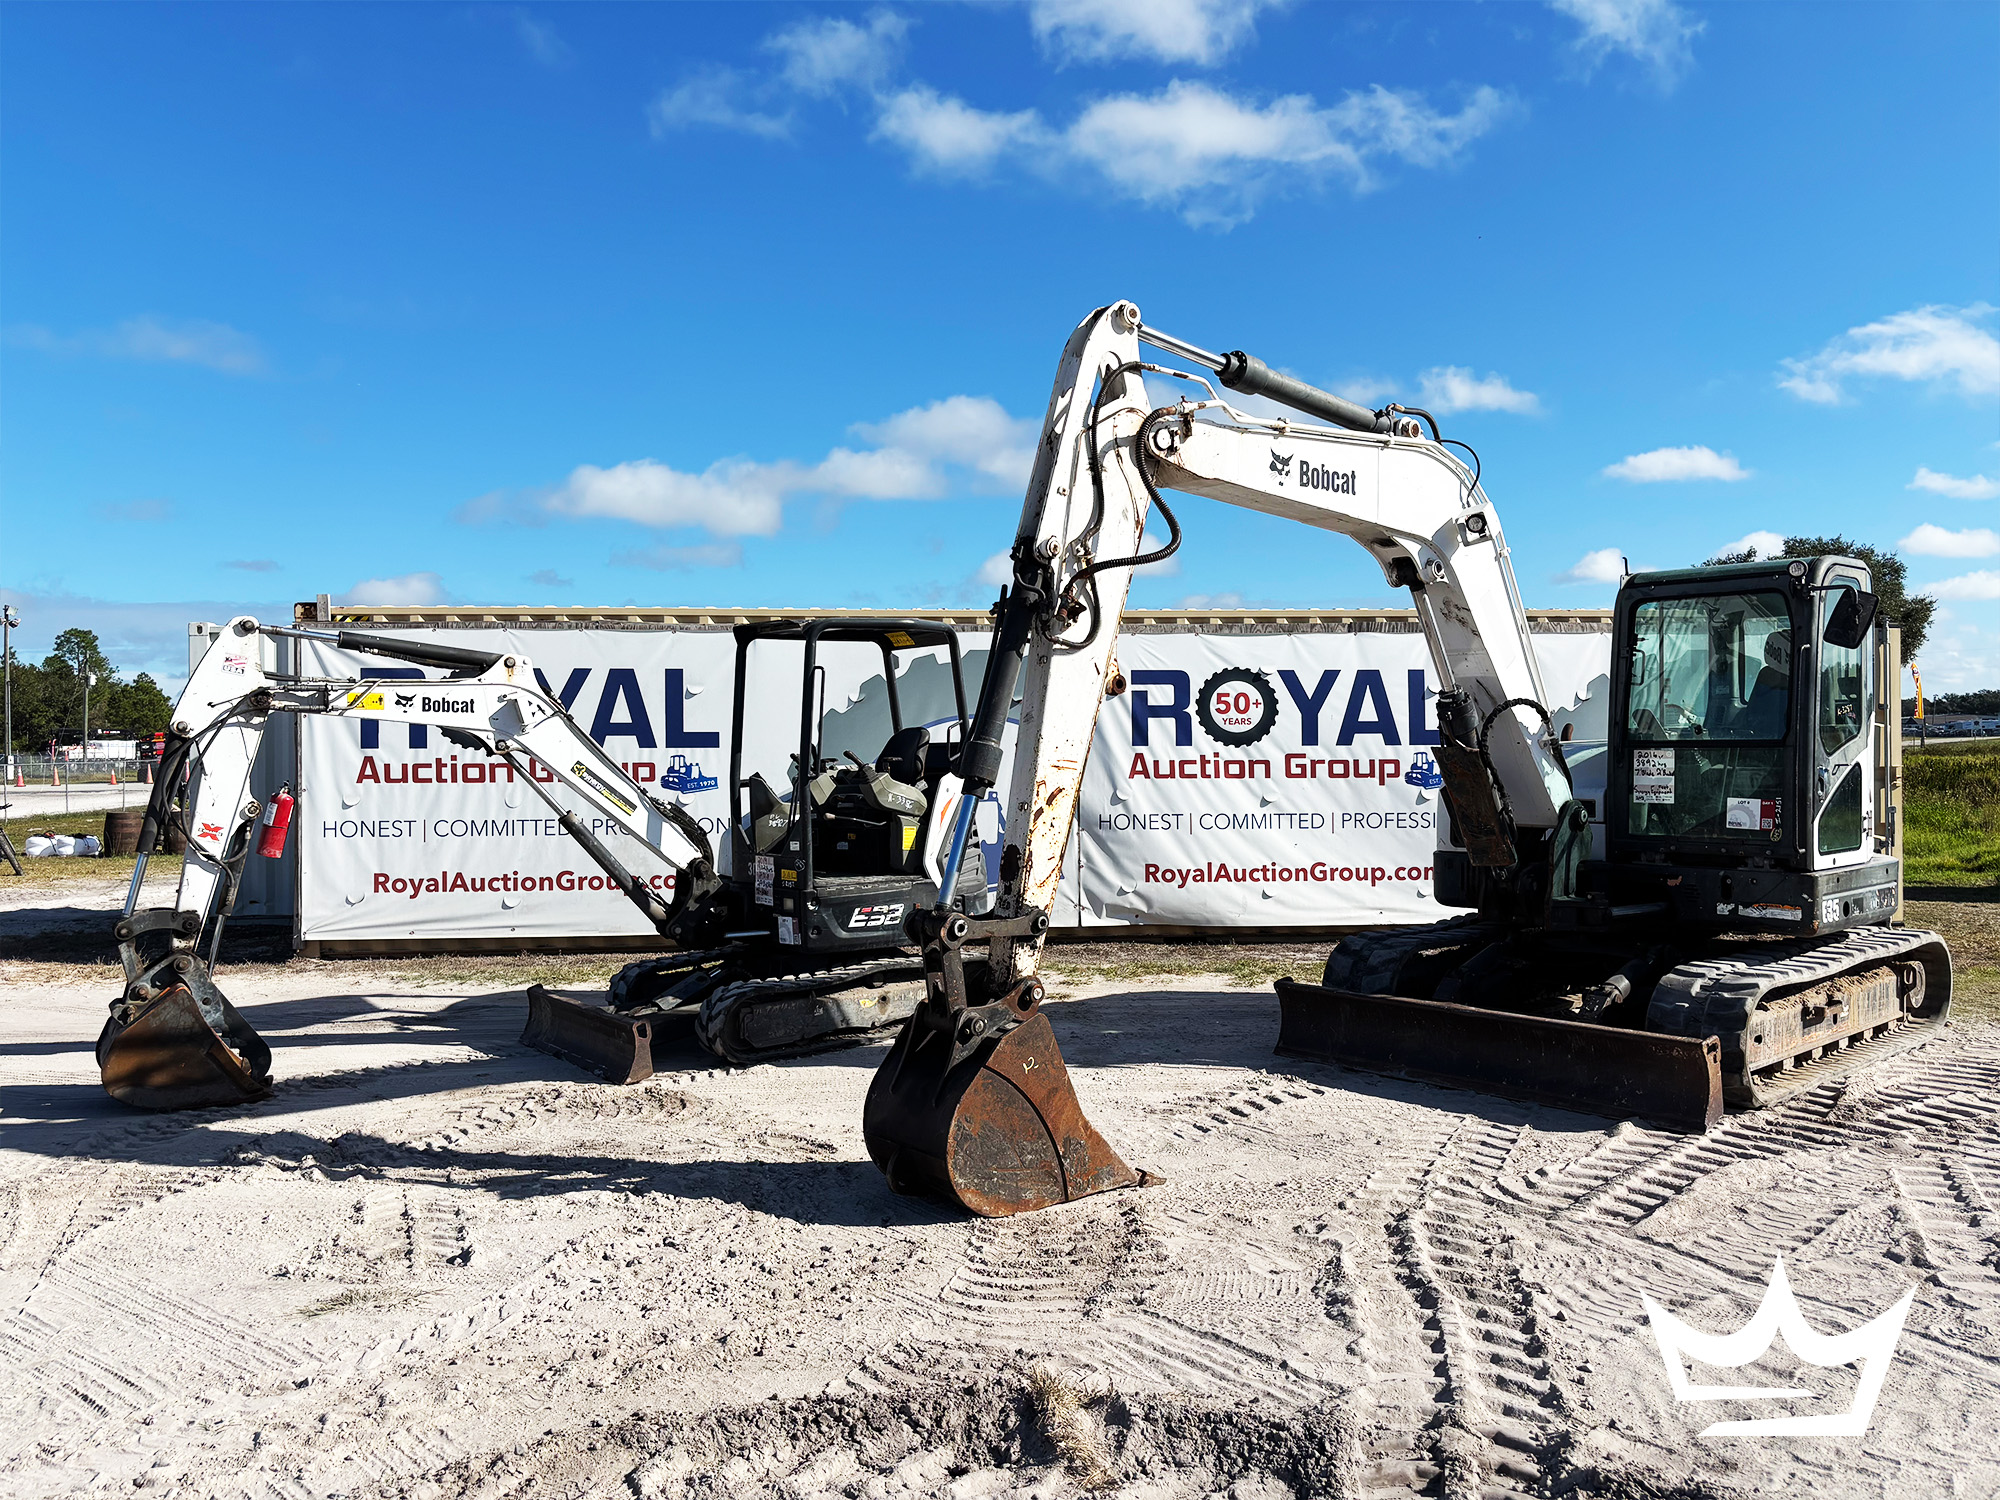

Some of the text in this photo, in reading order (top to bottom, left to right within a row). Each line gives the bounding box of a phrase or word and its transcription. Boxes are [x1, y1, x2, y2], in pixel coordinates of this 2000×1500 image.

[1299, 459, 1357, 496] Bobcat
[422, 697, 475, 714] Bobcat
[1215, 692, 1262, 716] 50+
[1222, 717, 1252, 726] YEARS
[356, 755, 514, 784] Auction
[1129, 752, 1401, 786] Auction Group
[323, 819, 417, 838] HONEST
[1098, 812, 1436, 832] HONEST COMMITTED PROFESSI
[374, 871, 677, 899] RoyalAuctionGrou.co
